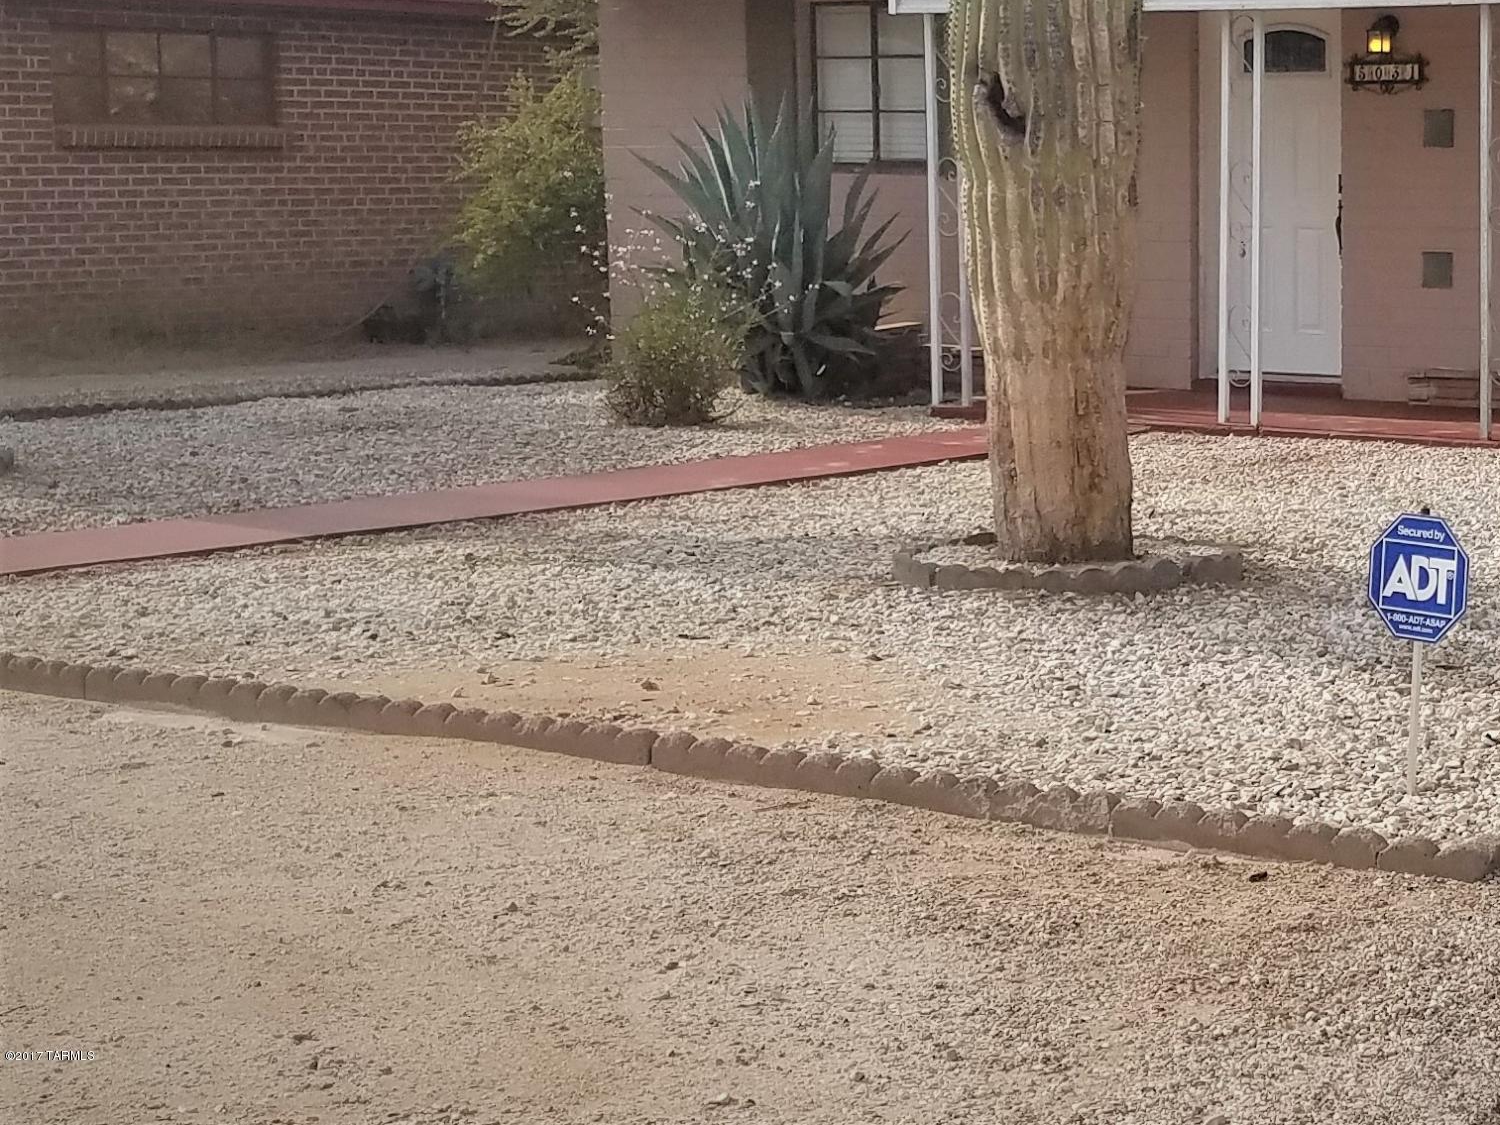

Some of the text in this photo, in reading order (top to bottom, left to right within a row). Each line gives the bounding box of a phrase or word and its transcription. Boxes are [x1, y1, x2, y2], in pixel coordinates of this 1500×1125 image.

[1397, 525, 1445, 542] Secured by
[1382, 553, 1455, 605] ADT
[1387, 613, 1446, 628] 1-800-ADT-ASAP
